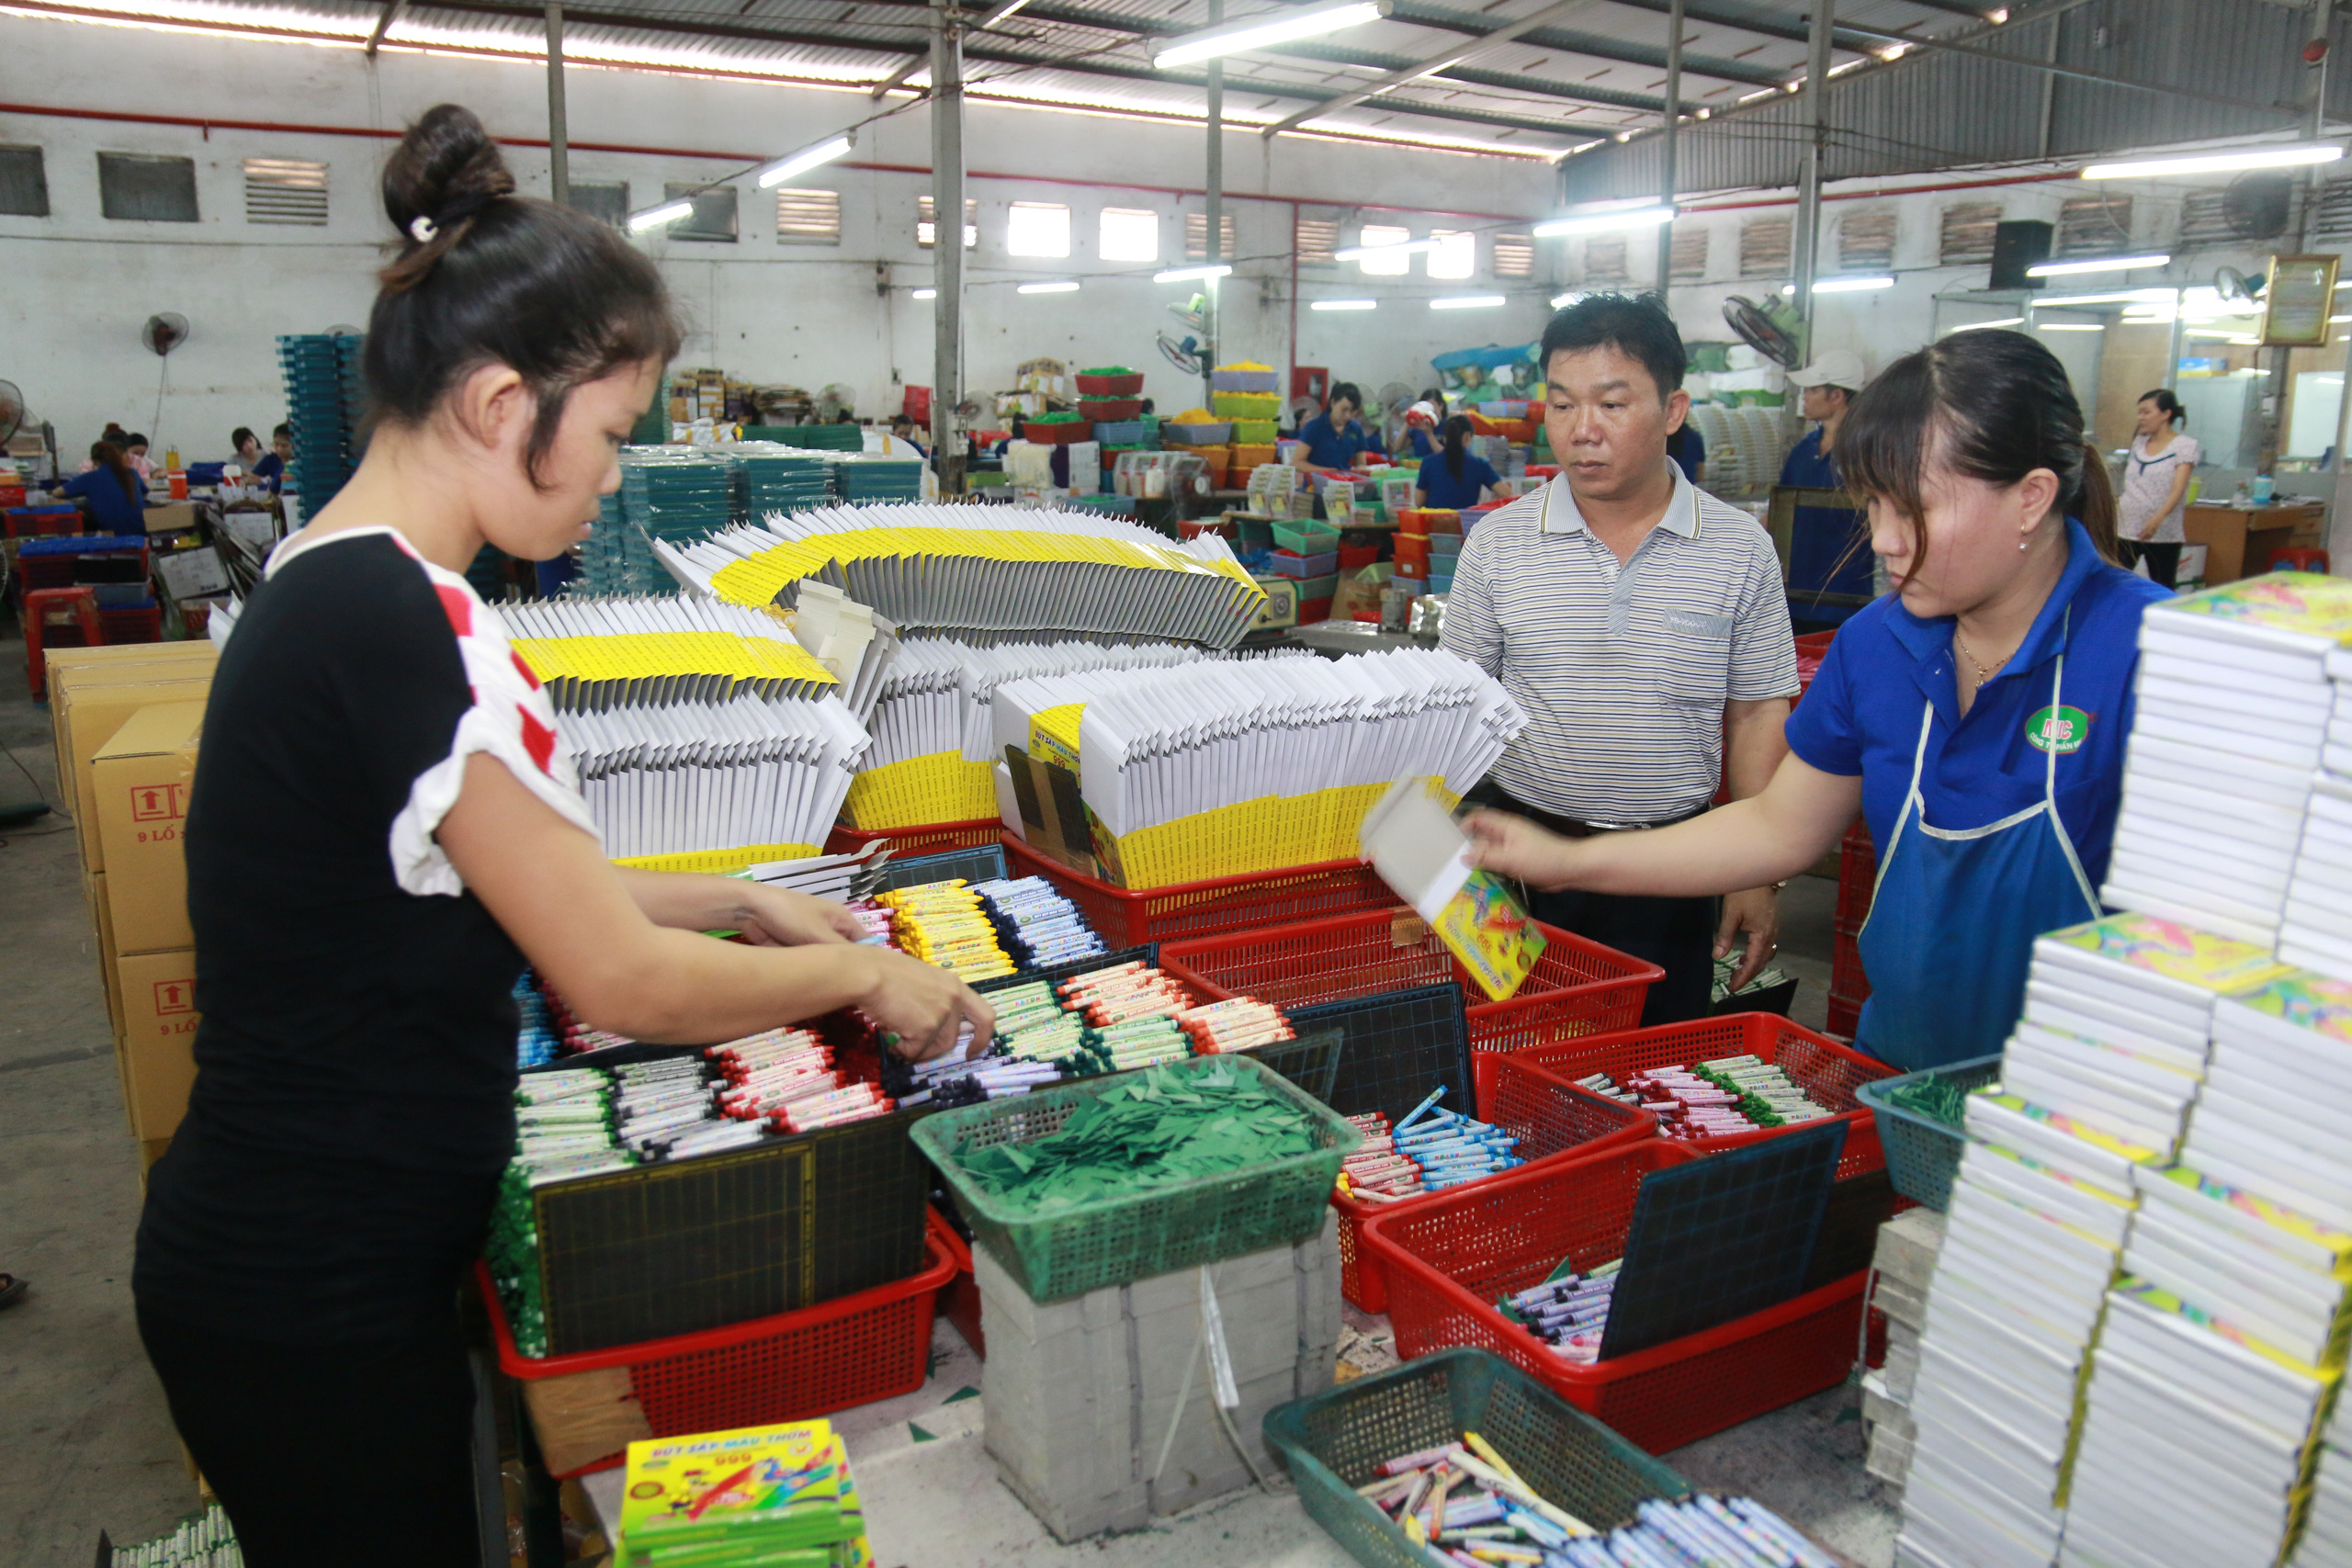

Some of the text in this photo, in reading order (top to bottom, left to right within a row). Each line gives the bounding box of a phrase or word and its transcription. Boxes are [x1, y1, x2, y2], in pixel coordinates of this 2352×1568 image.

[1053, 755, 1066, 768] 999
[138, 825, 175, 842] 9 LỐ
[161, 1016, 198, 1035] 9 LỐ
[651, 1446, 684, 1458] BÚT
[688, 1442, 718, 1453] SÁP
[724, 1437, 760, 1450] MÀU
[767, 1429, 812, 1443] THƠM
[715, 1452, 752, 1466] 999
